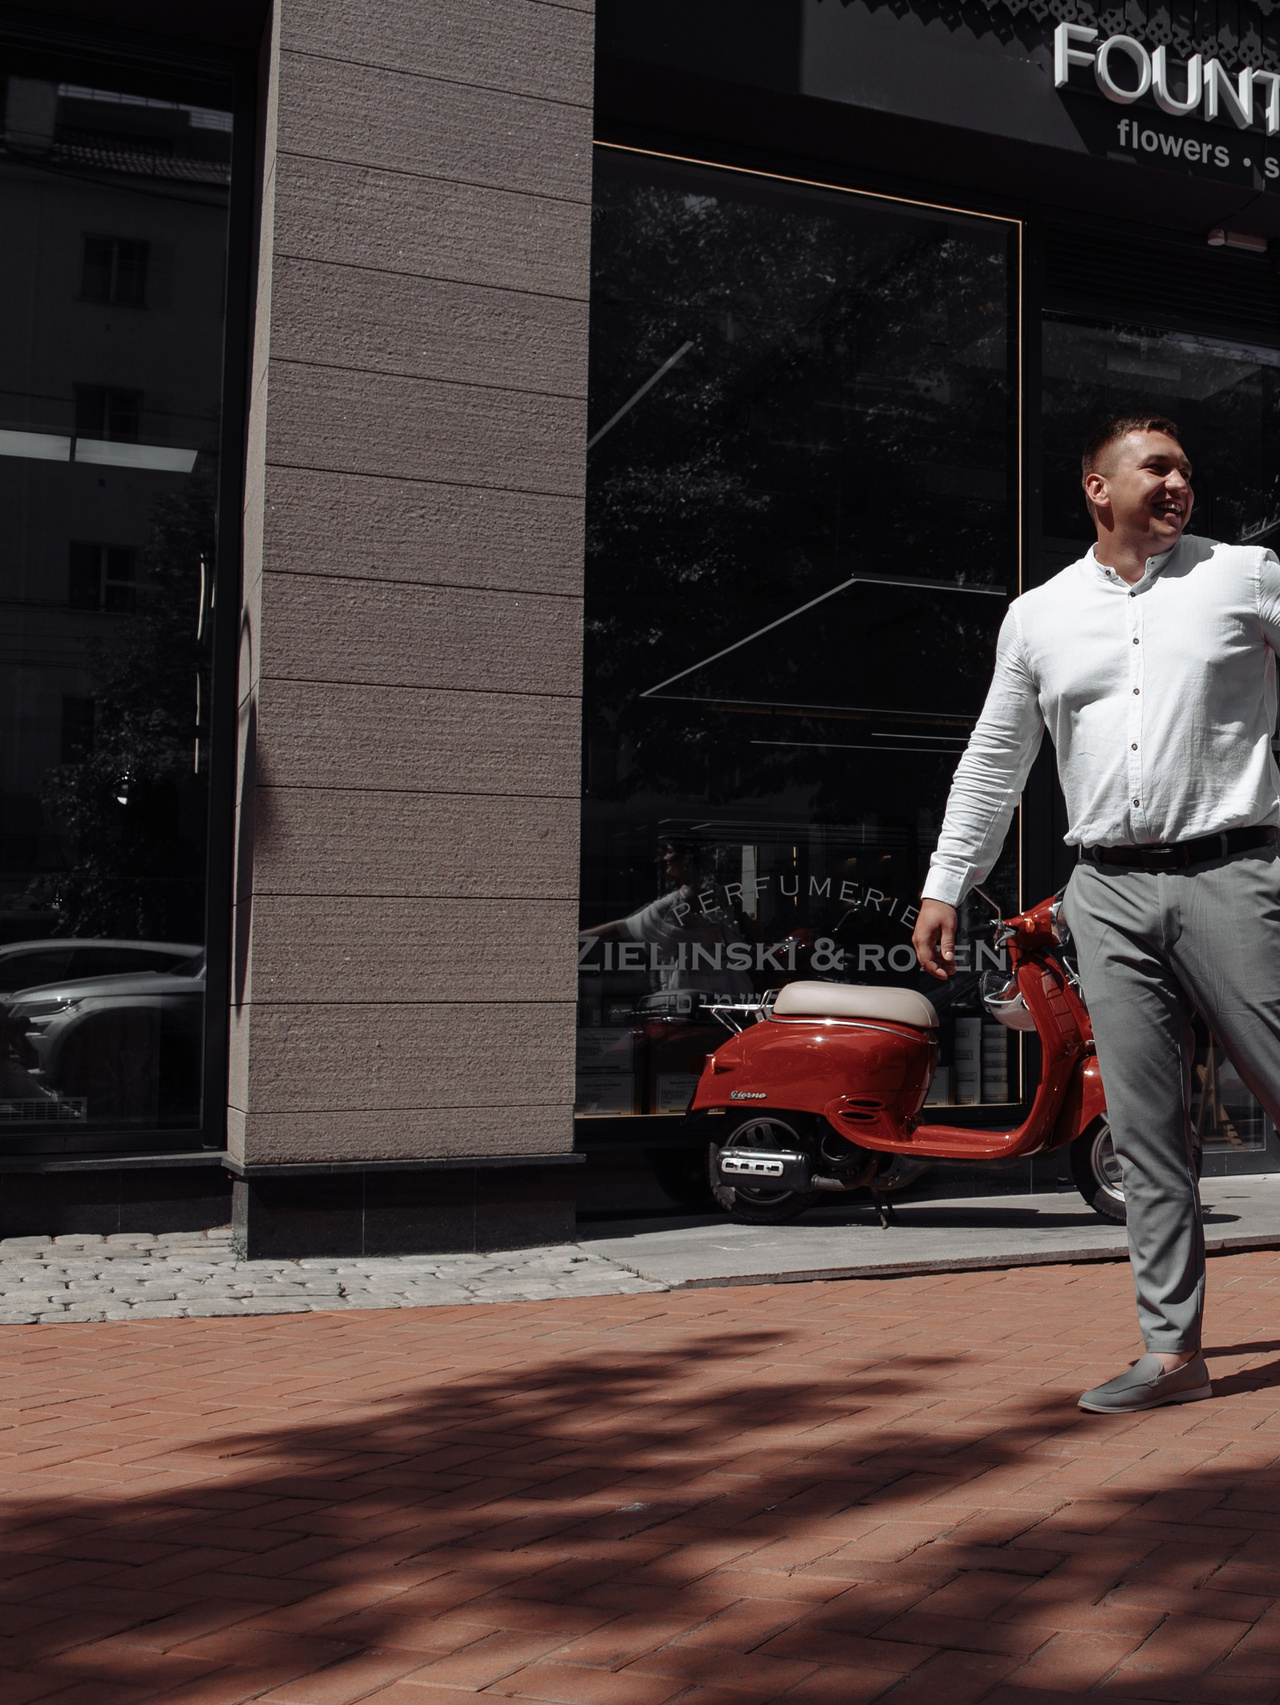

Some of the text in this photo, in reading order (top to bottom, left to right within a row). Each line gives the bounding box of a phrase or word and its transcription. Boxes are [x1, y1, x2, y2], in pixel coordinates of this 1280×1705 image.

[1117, 118, 1230, 167] flowers
[672, 874, 920, 929] PERFUMERIE
[578, 936, 1008, 973] ZIELINSKI & ROEN
[729, 1089, 767, 1100] Giorno
